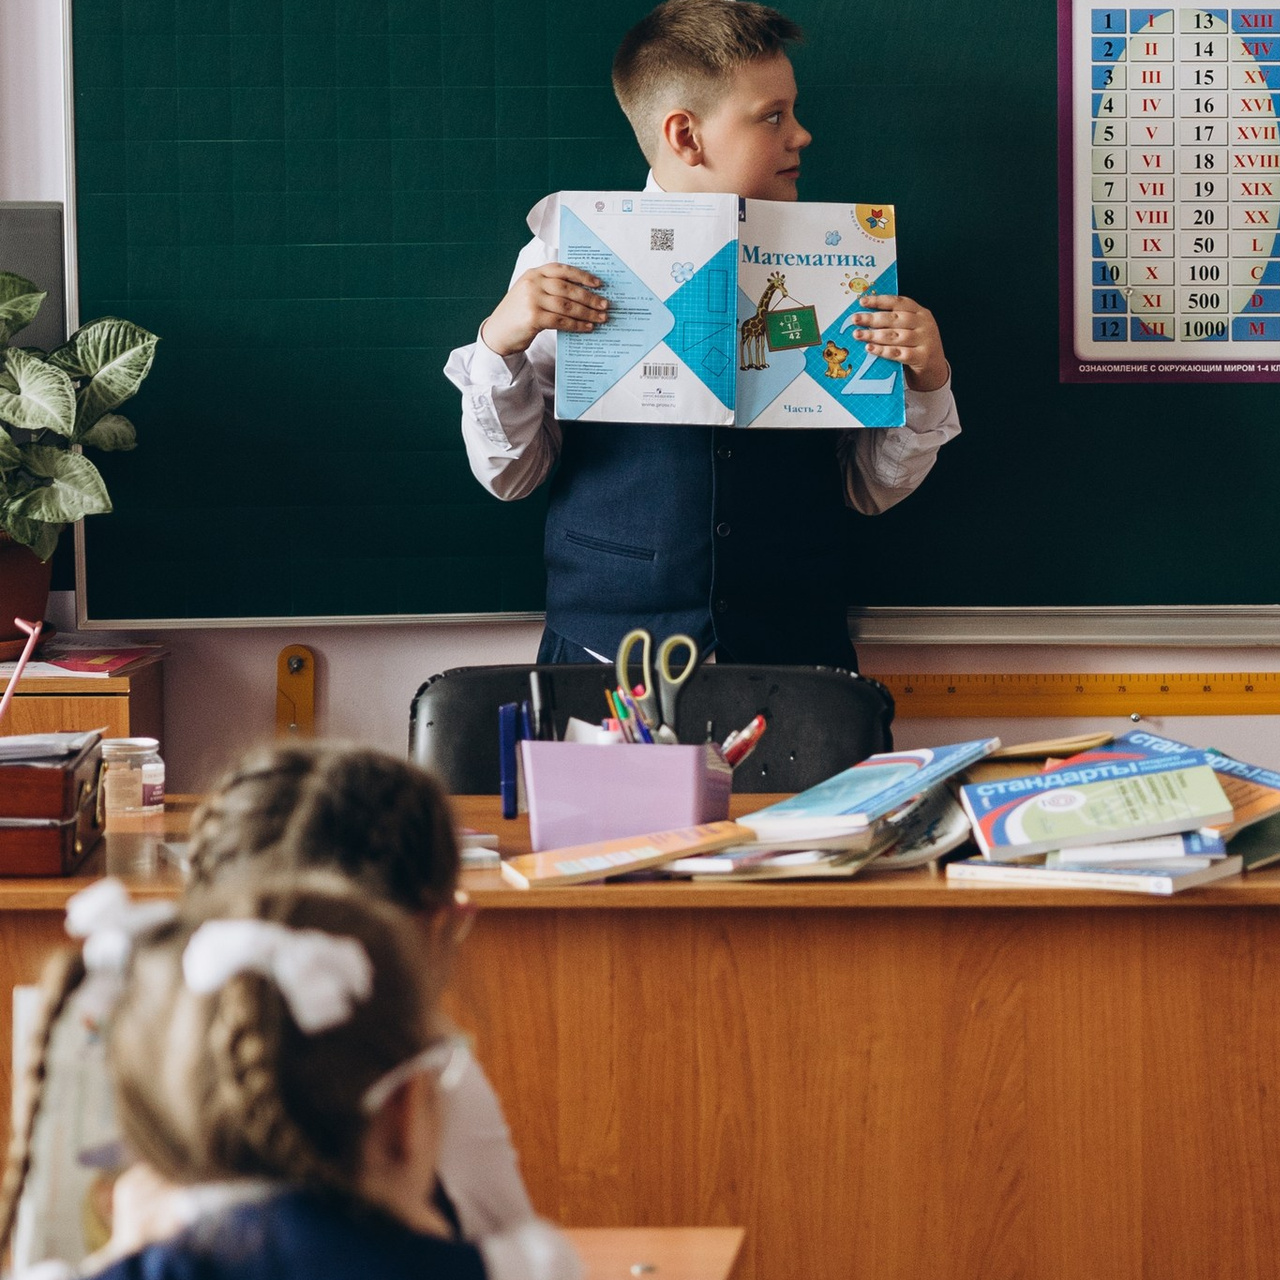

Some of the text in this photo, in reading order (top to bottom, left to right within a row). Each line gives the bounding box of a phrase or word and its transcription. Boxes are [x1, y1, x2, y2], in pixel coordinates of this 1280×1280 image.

[1104, 13, 1112, 29] 1
[1148, 14, 1155, 28] I
[1194, 13, 1214, 29] 13
[1239, 14, 1274, 28] XIII
[741, 244, 877, 268] Математика
[789, 332, 801, 340] 42
[1157, 365, 1222, 373] ОКРУЖАЮЩИМ
[1224, 364, 1255, 372] МИРОМ
[1257, 364, 1269, 372] 1-4
[783, 404, 823, 413] Часть 2
[976, 762, 1140, 798] стандарты
